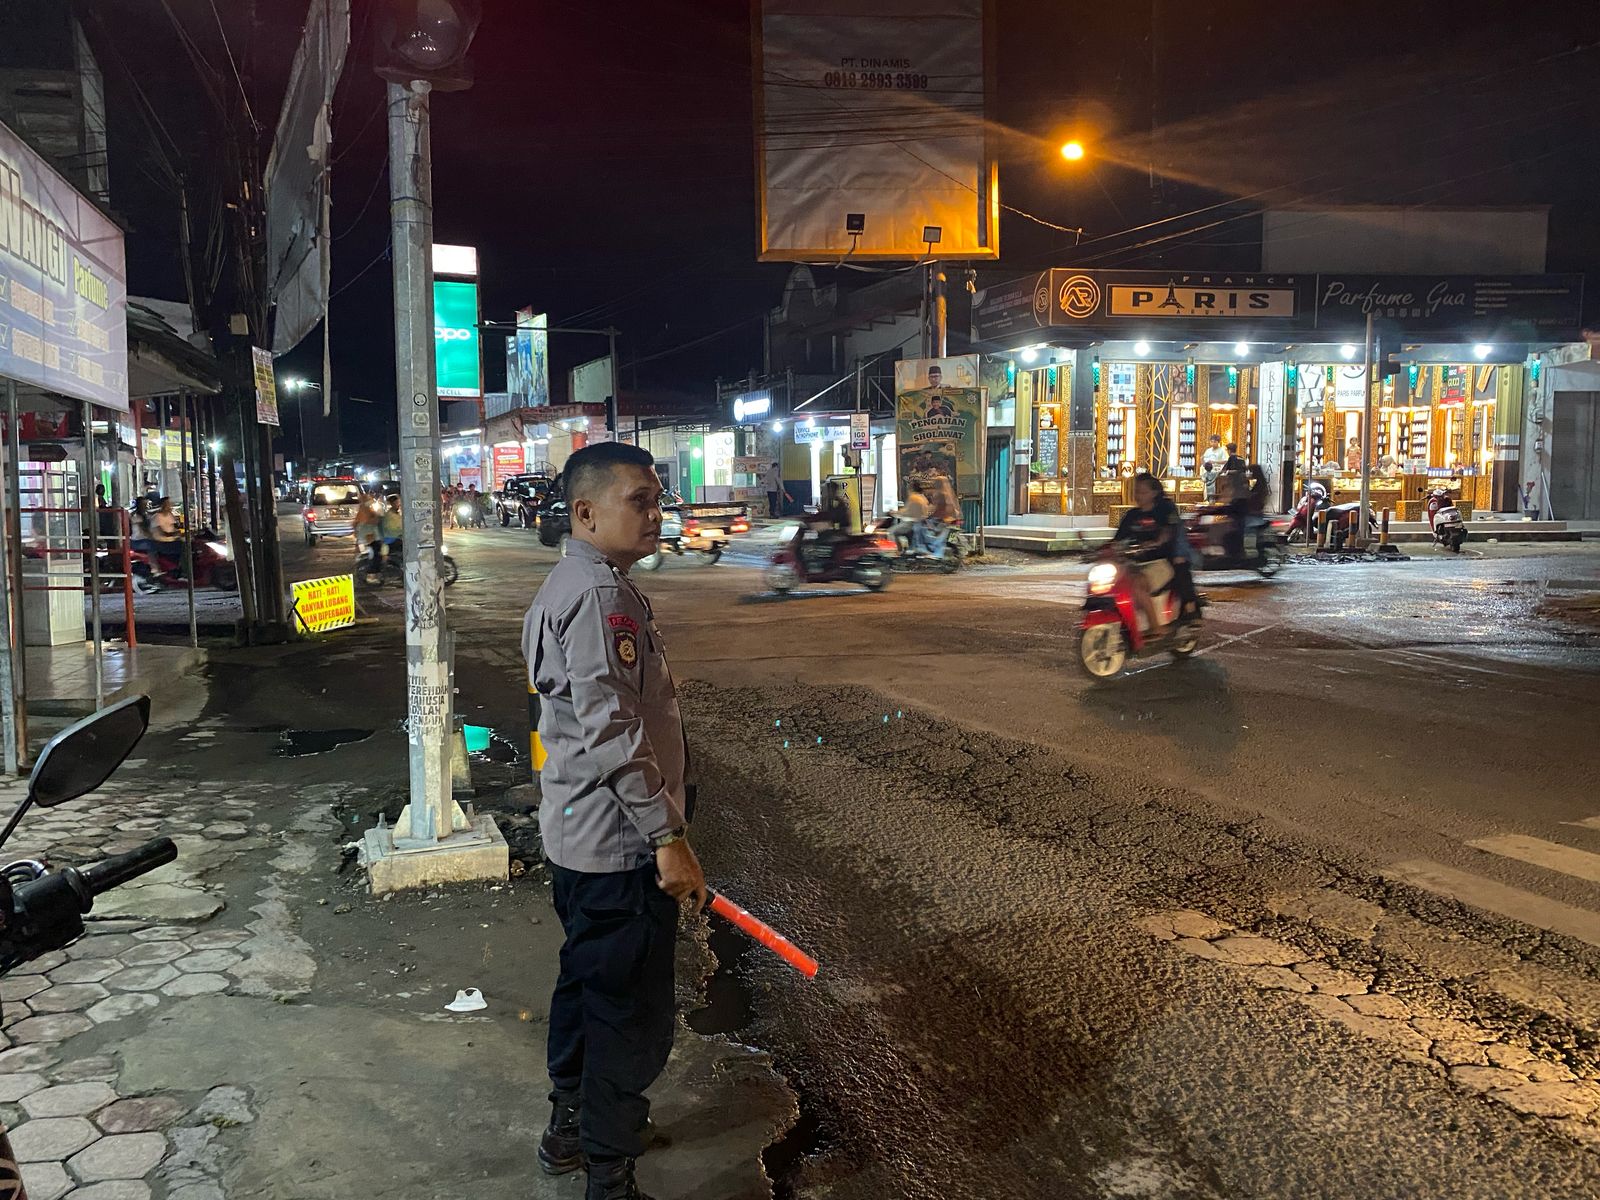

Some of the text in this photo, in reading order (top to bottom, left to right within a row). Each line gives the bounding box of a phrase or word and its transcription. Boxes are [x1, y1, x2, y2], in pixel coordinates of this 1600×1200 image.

[841, 58, 911, 68] PT. DINAMIS
[73, 254, 109, 312] Parfume
[1183, 276, 1294, 284] FRANCE
[1131, 286, 1270, 309] PARIS
[1322, 281, 1466, 313] Parfume Gua
[910, 417, 966, 430] PENGAJIAN
[913, 431, 965, 442] SHOLAWAT
[308, 590, 321, 600] HATI
[326, 586, 340, 596] HATI
[301, 595, 349, 614] BANYAK LUBANG
[303, 613, 318, 625] ALAN
